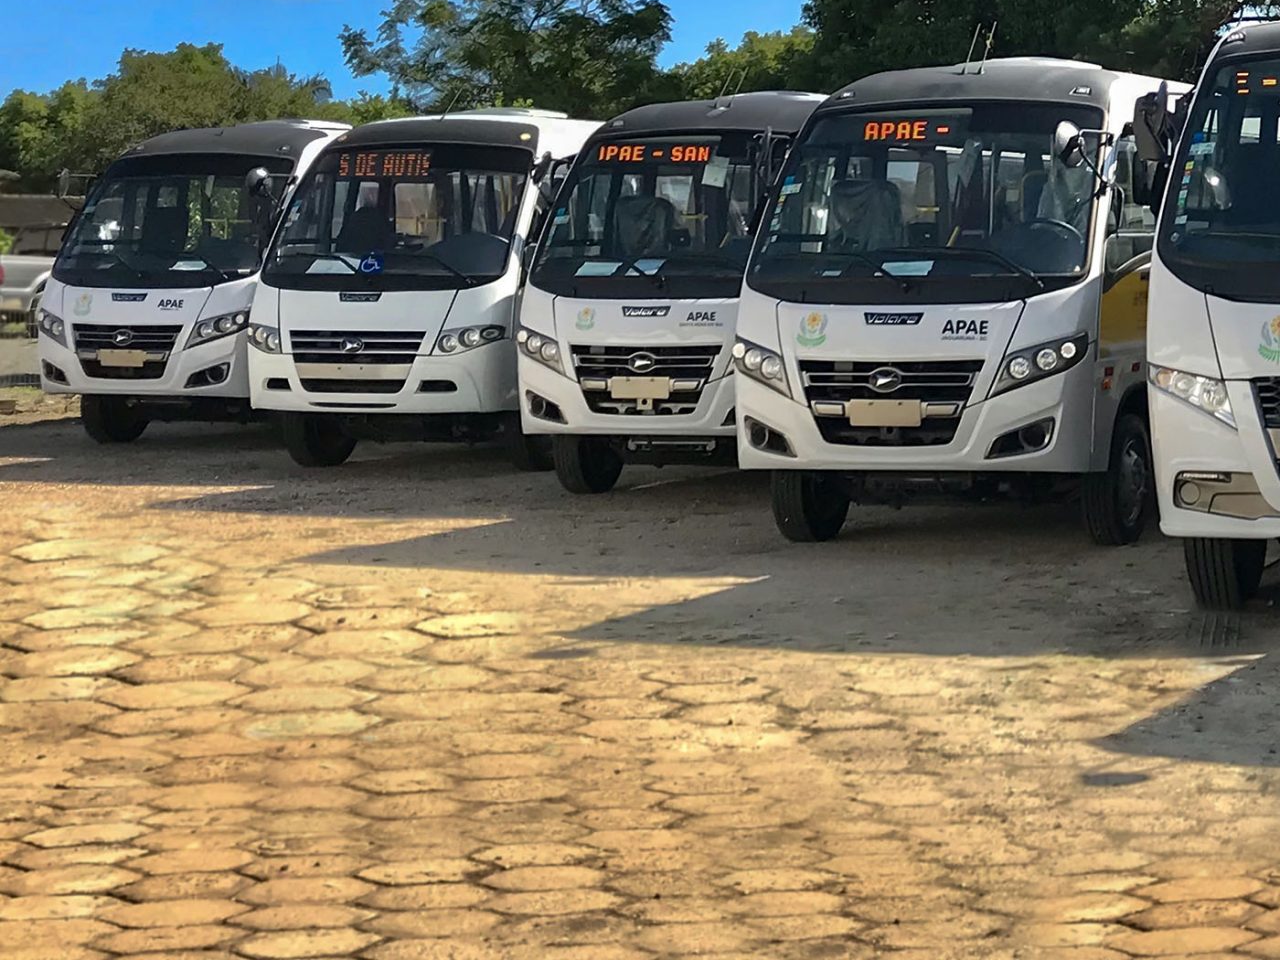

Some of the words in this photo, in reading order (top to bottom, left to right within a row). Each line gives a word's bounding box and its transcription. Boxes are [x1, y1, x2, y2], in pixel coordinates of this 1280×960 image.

[864, 121, 928, 140] APAE
[670, 146, 709, 161] SAN
[355, 153, 379, 176] DE
[158, 300, 184, 308] APAE
[686, 312, 717, 321] APAE
[942, 320, 989, 335] APAE
